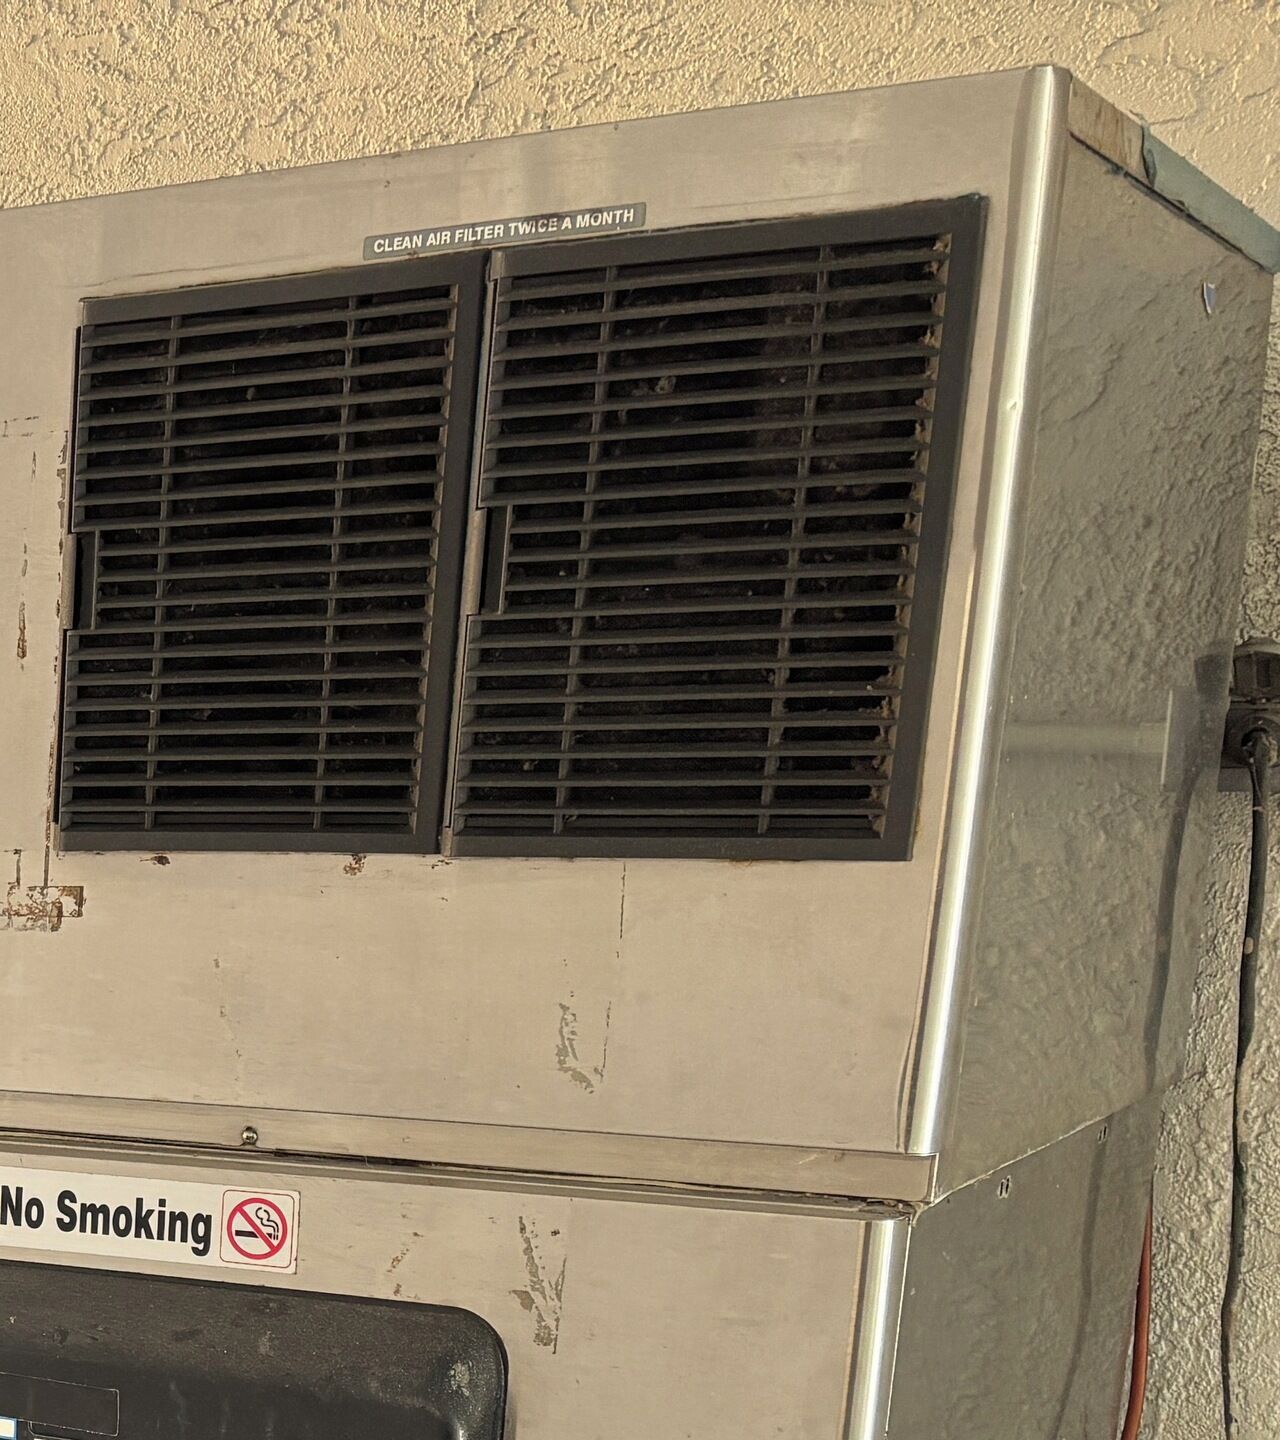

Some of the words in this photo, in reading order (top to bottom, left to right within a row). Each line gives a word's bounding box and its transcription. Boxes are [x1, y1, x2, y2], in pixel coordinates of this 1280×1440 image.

[373, 235, 422, 253] CLEAN
[426, 231, 451, 247] AIR
[454, 224, 504, 244] FILTER
[508, 218, 558, 236] TWICE
[561, 216, 572, 229] A
[576, 208, 634, 228] MONTH
[0, 1185, 45, 1230] No
[55, 1189, 213, 1257] Smoking
